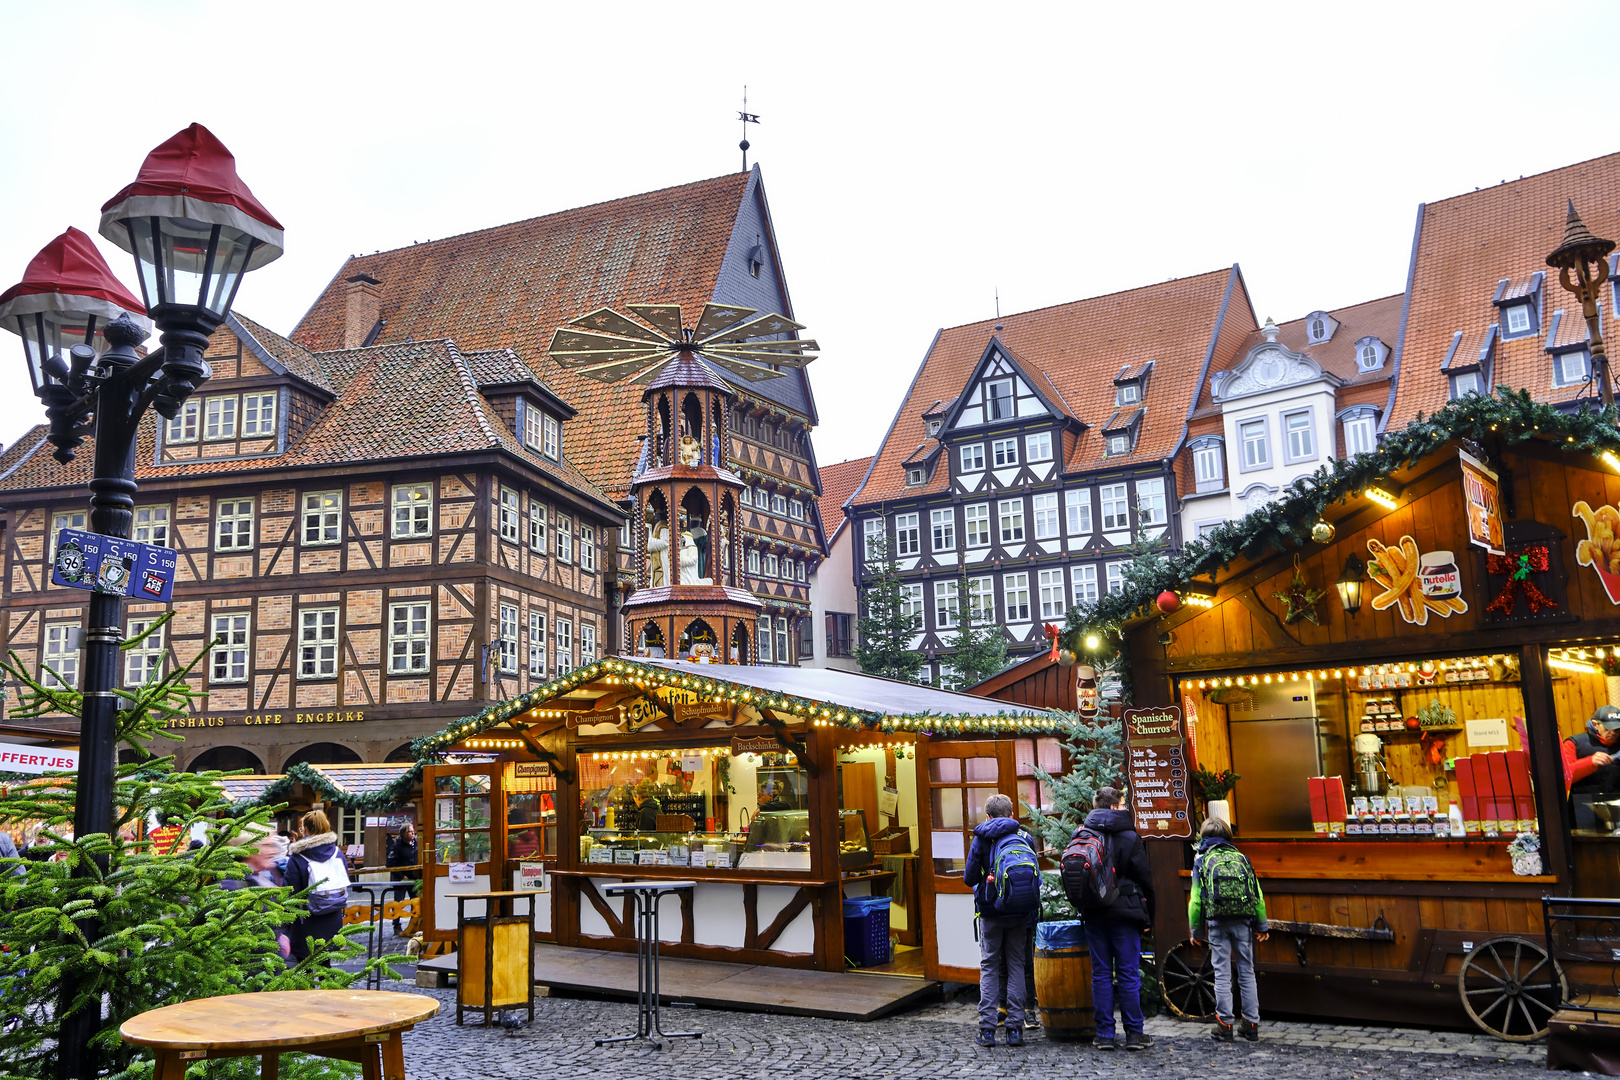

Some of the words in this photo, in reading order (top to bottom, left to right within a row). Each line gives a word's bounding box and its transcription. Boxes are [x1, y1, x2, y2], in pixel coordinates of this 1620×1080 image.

[83, 544, 99, 554] 150
[110, 545, 120, 556] S
[123, 551, 138, 562] 150
[148, 552, 158, 565] S
[64, 557, 78, 570] 96
[161, 558, 175, 569] 150
[147, 577, 163, 588] FCK
[1423, 573, 1457, 585] nutella
[145, 582, 161, 592] AFD
[244, 714, 283, 725] CAFE
[296, 711, 365, 724] ENGELKE
[575, 714, 614, 725] Champignon
[1132, 712, 1173, 725] Spanische
[1137, 725, 1170, 734] Churros
[737, 740, 780, 751] Backschinken
[0, 752, 74, 769] FFERTJES
[517, 764, 549, 775] Champignons
